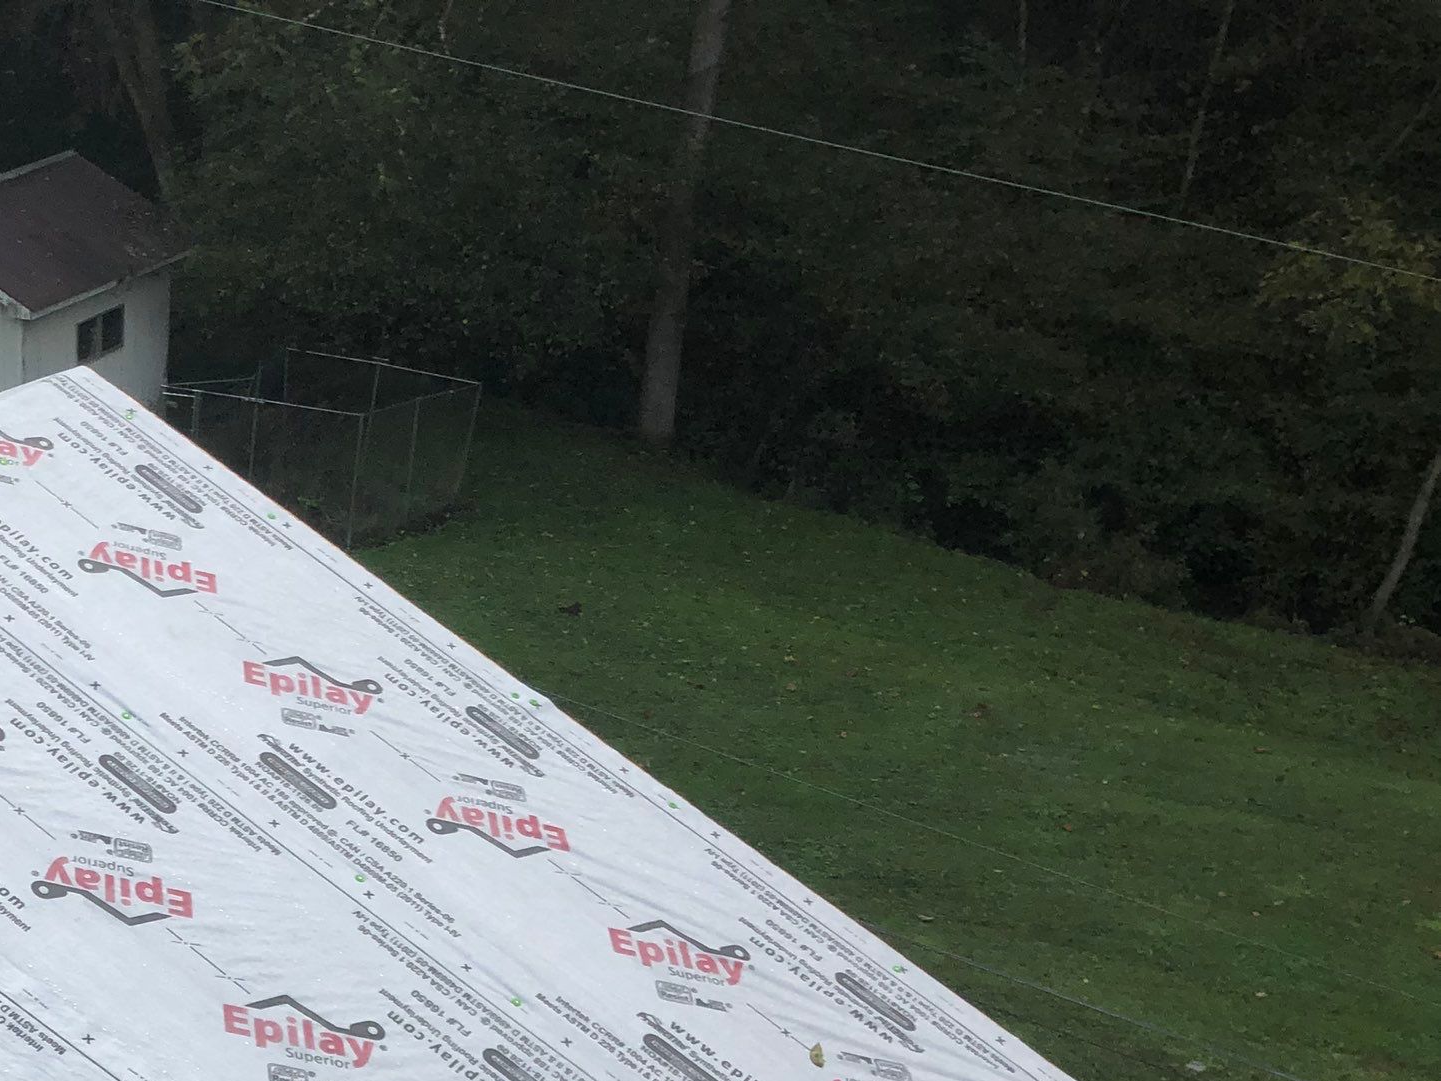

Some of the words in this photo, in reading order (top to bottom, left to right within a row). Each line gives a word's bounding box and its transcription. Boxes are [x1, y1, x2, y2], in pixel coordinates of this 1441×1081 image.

[59, 431, 176, 521] www.epilay.com
[89, 541, 217, 594] Epilay
[37, 702, 65, 722] 16850
[242, 660, 373, 715] Epilay
[296, 696, 353, 716] Superior
[68, 727, 91, 744] FL#
[385, 672, 514, 768] www.epilay.com
[10, 717, 146, 825] www.epilay.com
[288, 742, 425, 845] www.epilay.com
[435, 796, 571, 852] Epilay
[458, 795, 513, 814] Superior
[72, 854, 135, 877] Superior
[345, 819, 372, 842] FL#
[368, 836, 403, 862] 16850
[45, 857, 193, 918] Epilay
[607, 926, 748, 985] Epilay
[667, 966, 726, 988] Superior
[411, 990, 442, 1013] 16850
[748, 936, 895, 1043] www.epilay.com
[222, 1003, 375, 1068] Epilay
[445, 1015, 472, 1038] FL#
[285, 1046, 351, 1070] Superior
